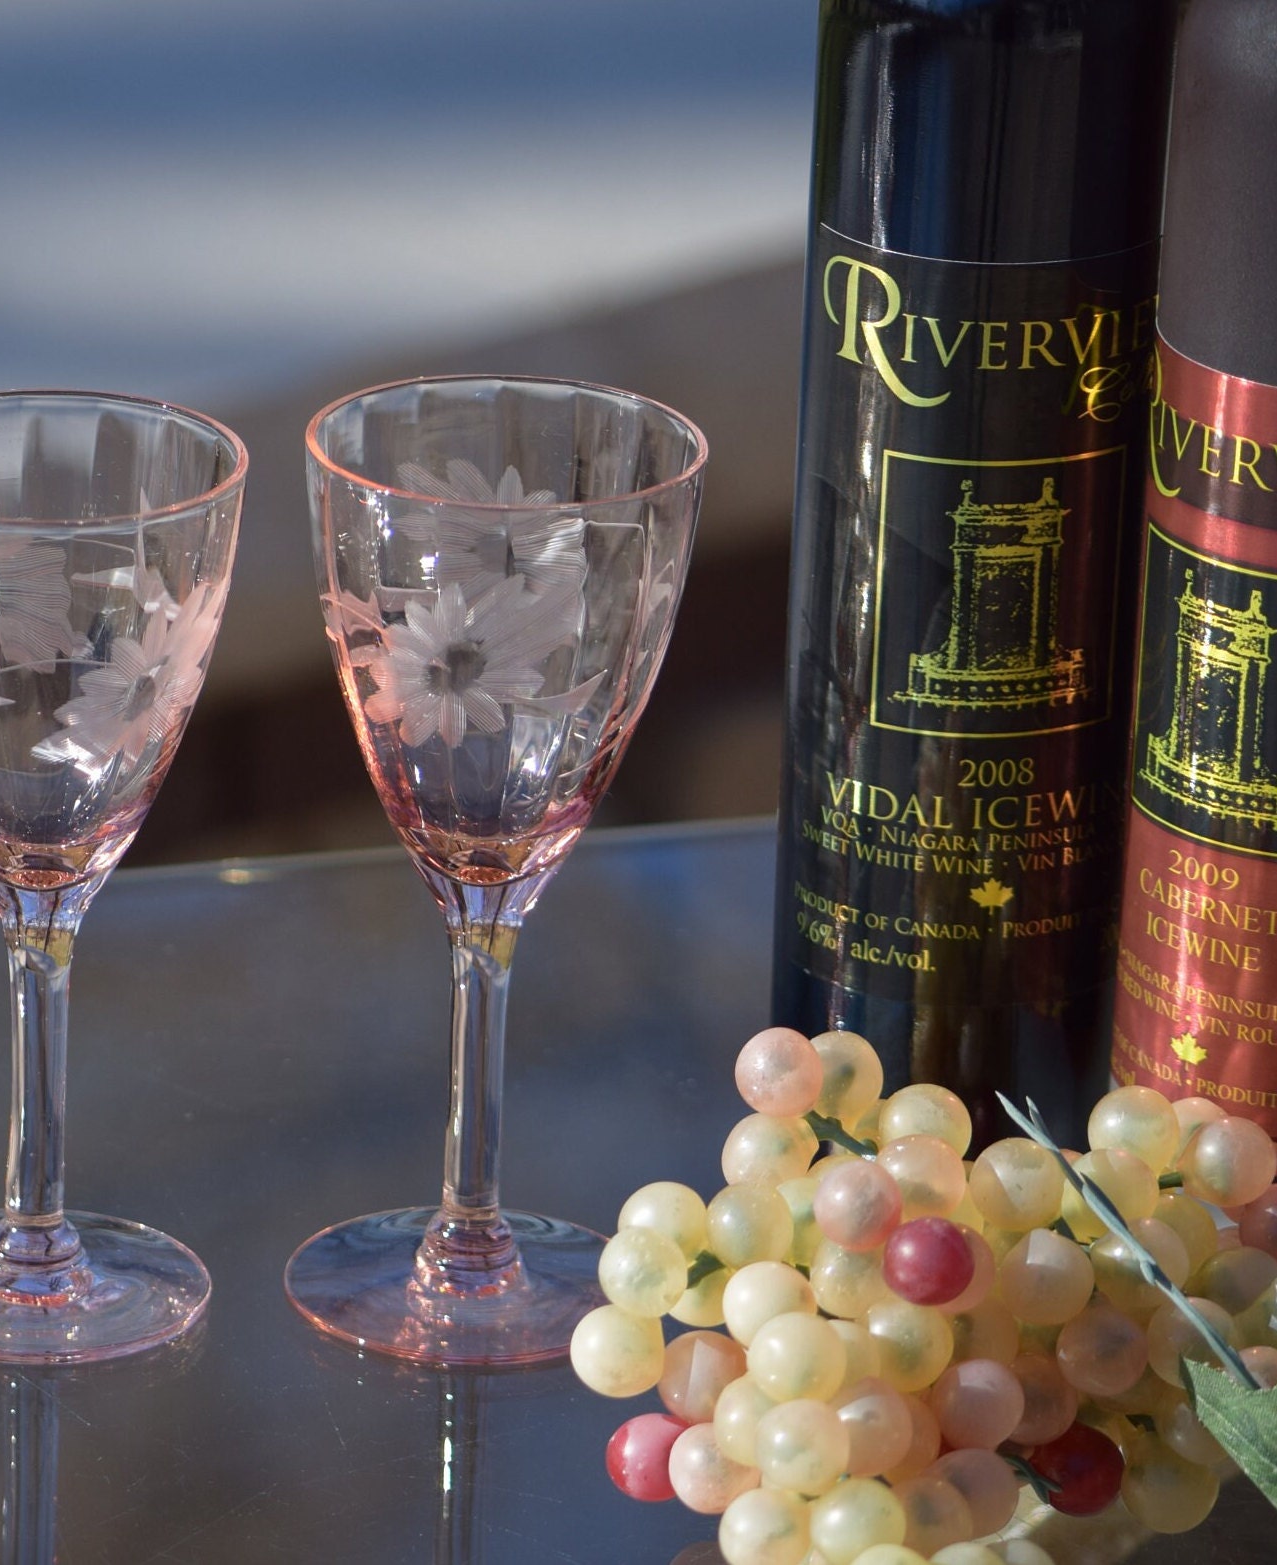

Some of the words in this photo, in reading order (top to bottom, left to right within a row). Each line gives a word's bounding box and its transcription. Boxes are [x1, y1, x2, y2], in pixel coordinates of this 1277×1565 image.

[823, 255, 1158, 408] RIVERVIE
[826, 771, 953, 829] VIDAL
[957, 757, 1034, 787] 2008
[802, 819, 850, 855] SWEET
[855, 841, 925, 872] WHITE
[932, 854, 993, 875] WINE
[1017, 853, 1055, 871] VIN
[821, 805, 861, 839] VQA
[880, 825, 980, 852] NIAGARA
[1168, 849, 1240, 891] 2009
[794, 880, 860, 924] PRODUCT
[864, 912, 889, 931] OF
[894, 917, 981, 940] CANADA
[1139, 867, 1277, 935] CABERNET
[796, 911, 838, 950] 9.6%
[849, 939, 937, 972] alc./vol.
[1145, 911, 1261, 972] ICEWINE
[1143, 988, 1181, 1022] WINE
[1197, 1012, 1230, 1037] VIN
[1128, 1048, 1182, 1087] CANADA
